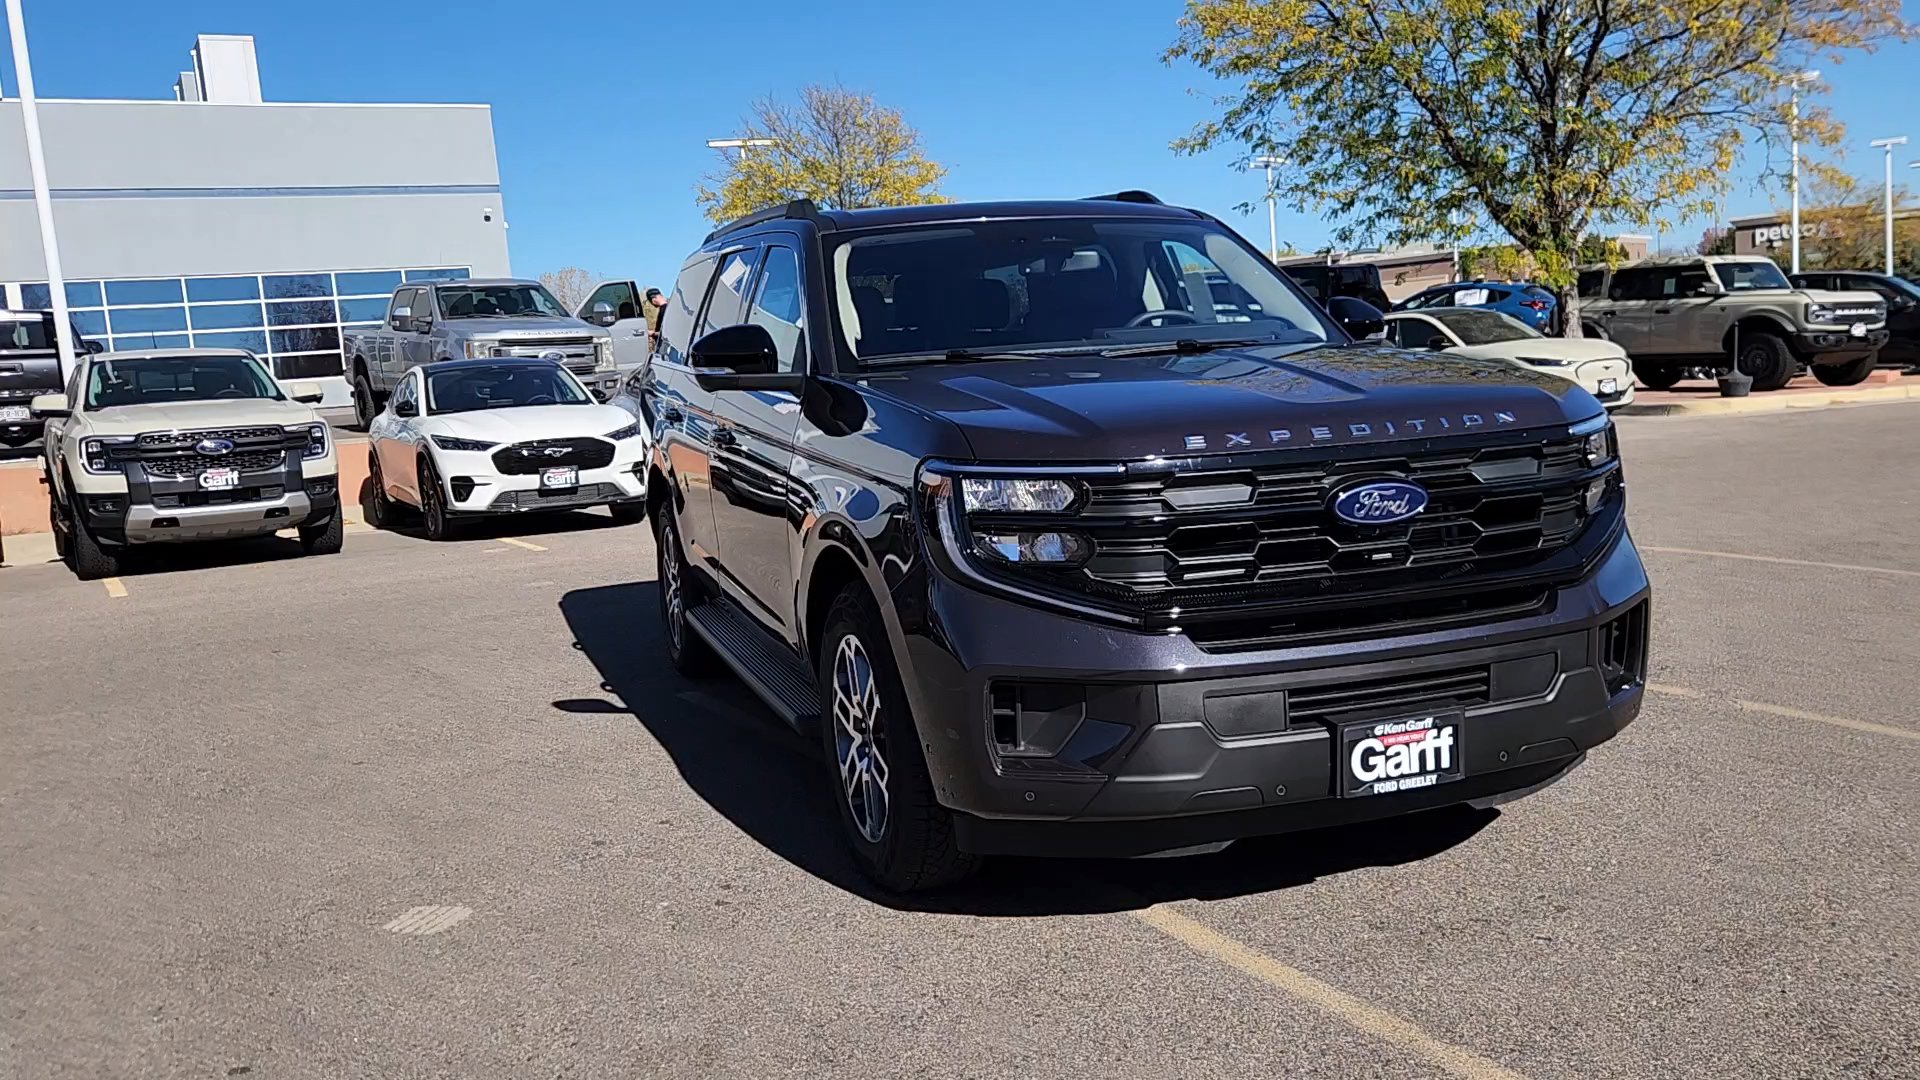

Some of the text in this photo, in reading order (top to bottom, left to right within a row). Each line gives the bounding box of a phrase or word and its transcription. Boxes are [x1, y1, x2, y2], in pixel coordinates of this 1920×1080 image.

[1755, 223, 1817, 247] peto
[1183, 410, 1518, 450] EXPEDITION
[199, 470, 240, 488] Garff
[543, 470, 577, 486] Garff
[1353, 488, 1410, 518] Ford
[1383, 717, 1434, 735] Ken Garff
[1350, 726, 1454, 782] Garff
[1373, 774, 1438, 794] FORD GREELEY
